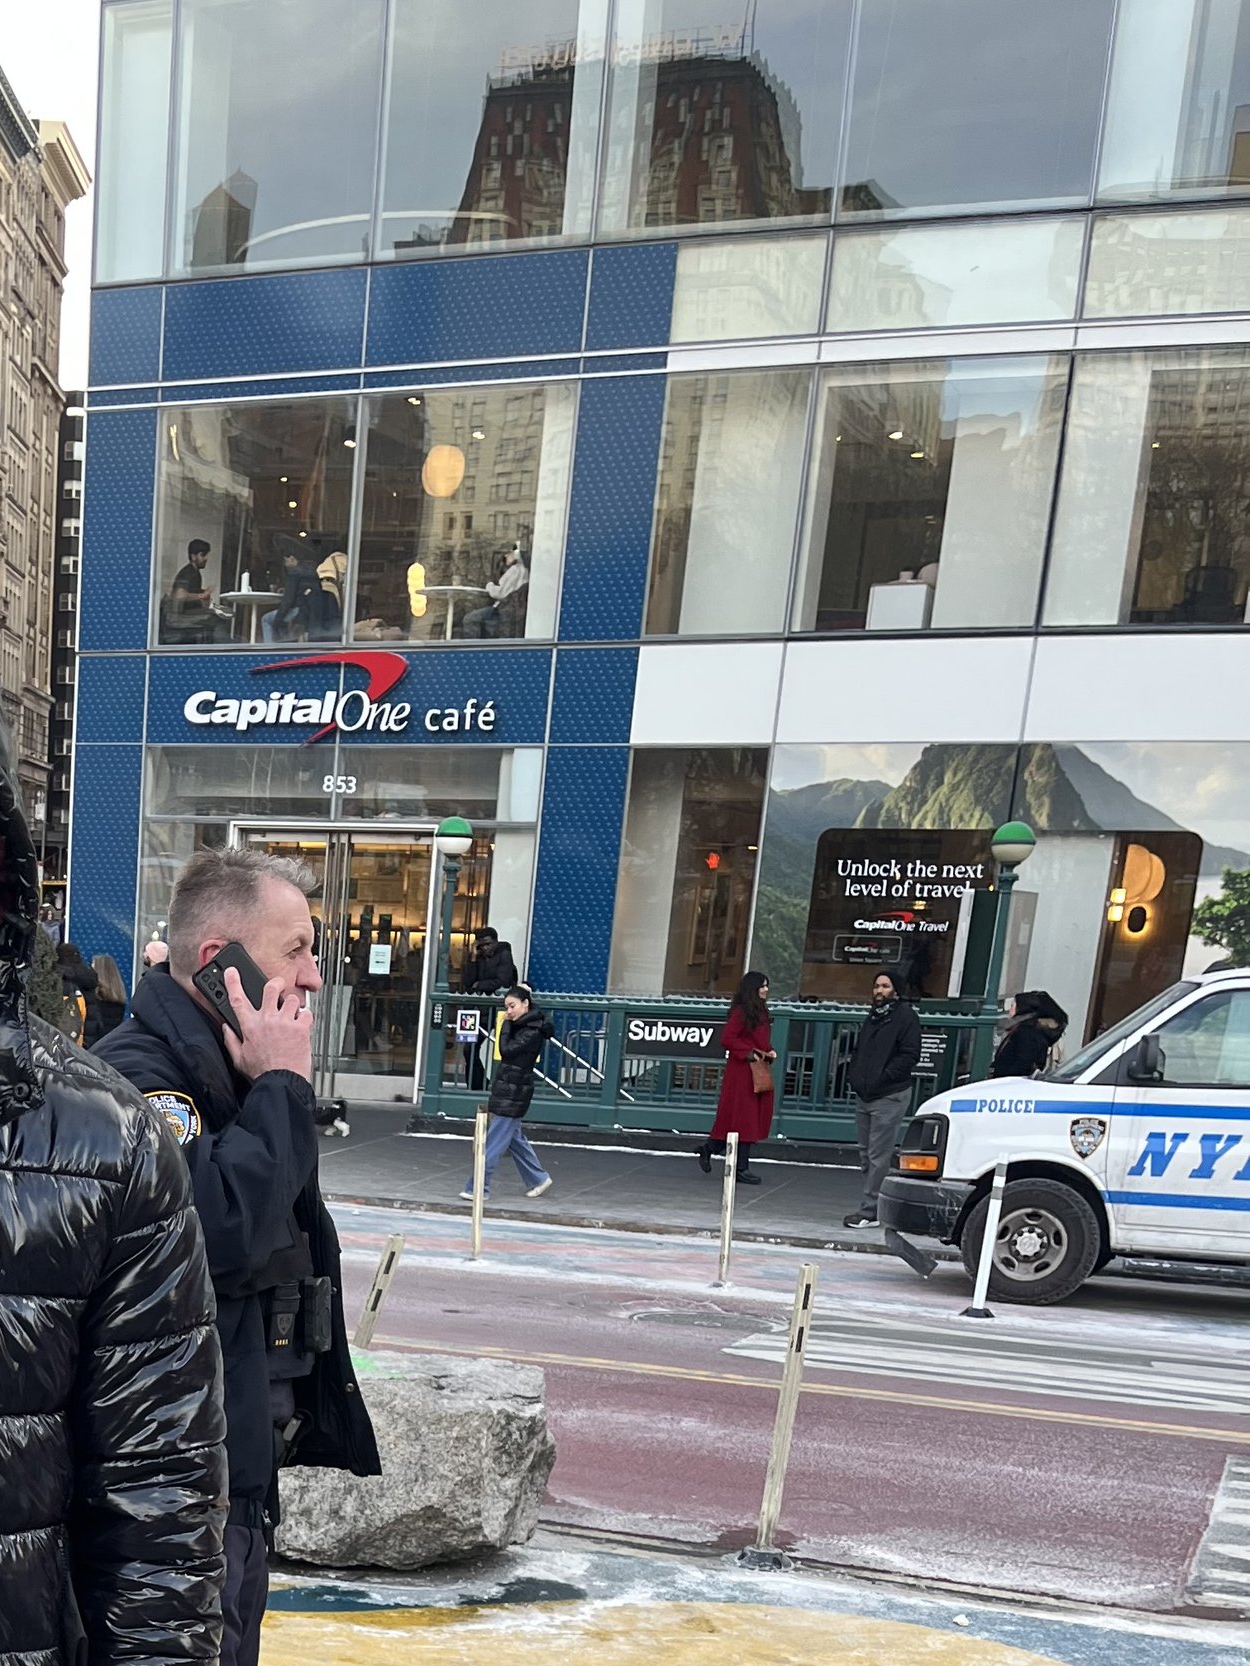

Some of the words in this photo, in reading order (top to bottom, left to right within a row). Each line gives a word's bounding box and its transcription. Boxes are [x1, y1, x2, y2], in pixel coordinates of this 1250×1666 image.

[424, 698, 496, 731] café
[322, 775, 357, 794] 853
[837, 859, 901, 877] Unlock
[906, 859, 938, 878] the
[942, 863, 984, 878] next
[844, 879, 887, 897] level
[891, 879, 913, 898] of
[919, 921, 949, 932] Travel
[628, 1019, 714, 1047] Subway
[148, 1095, 177, 1105] OLICE
[154, 1103, 191, 1112] RTMENT
[977, 1099, 1034, 1114] POLICE
[1127, 1131, 1250, 1180] NY
